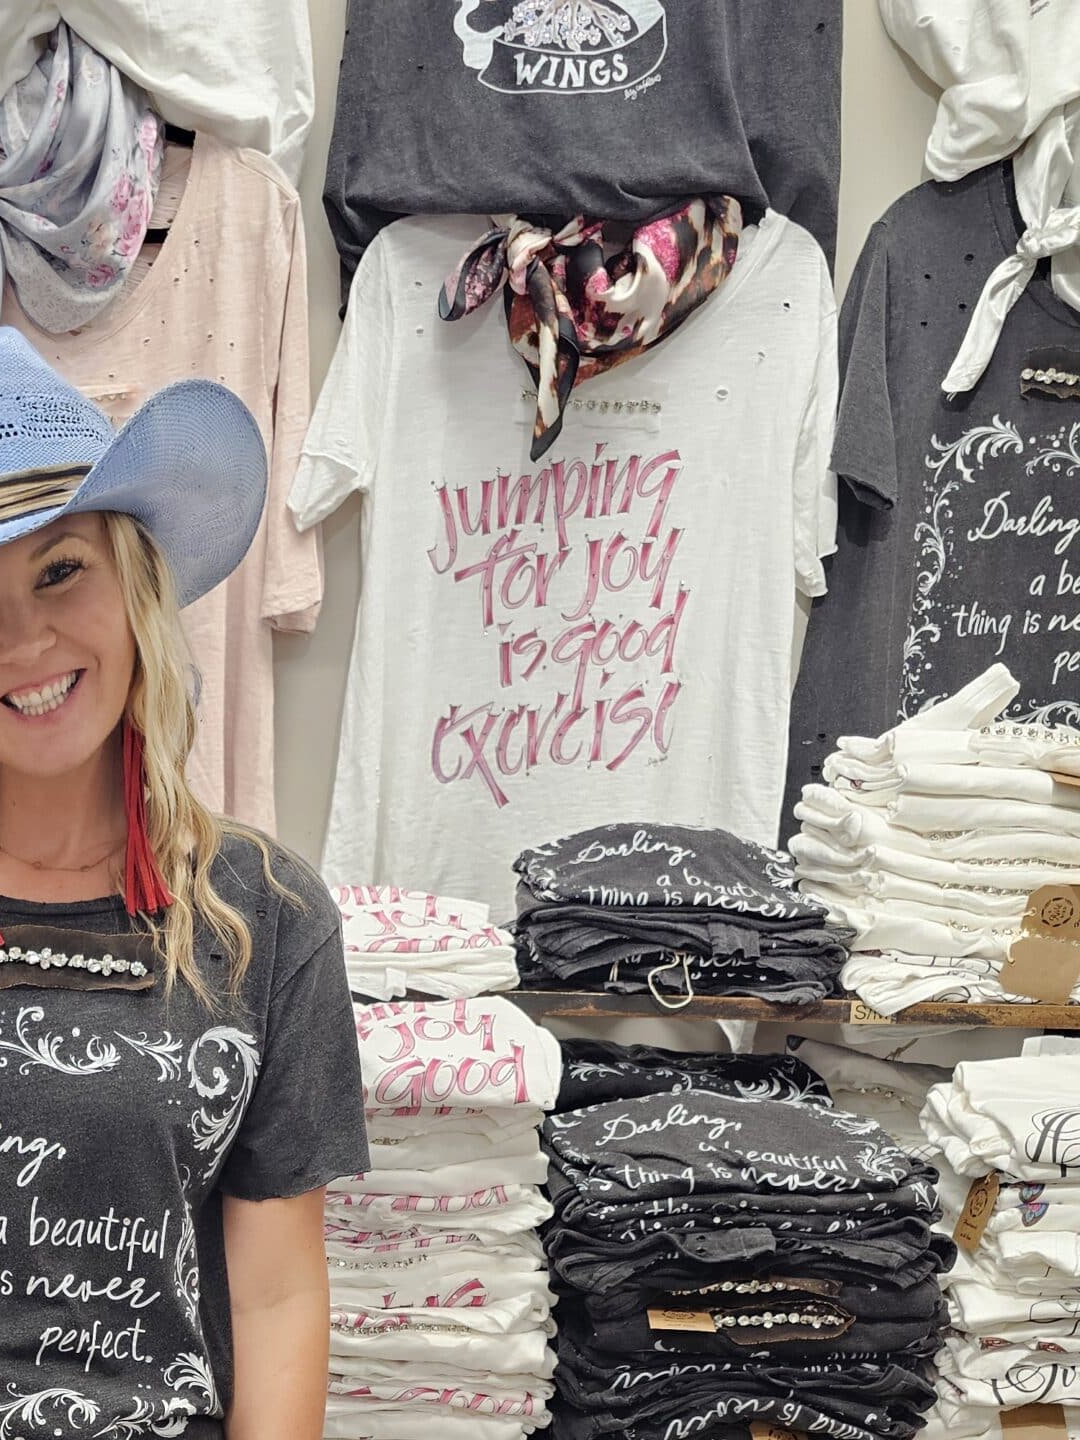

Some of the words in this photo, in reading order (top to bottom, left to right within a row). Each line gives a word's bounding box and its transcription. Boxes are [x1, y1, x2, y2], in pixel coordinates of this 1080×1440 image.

[514, 52, 629, 89] WINGS
[497, 620, 548, 688] is
[551, 582, 691, 714] good
[952, 601, 1013, 656] thing
[1022, 610, 1042, 635] is
[431, 671, 682, 810] exercise
[373, 1040, 530, 1109] good
[710, 1163, 732, 1180] is
[28, 1196, 170, 1270] beautiful
[26, 1273, 160, 1309] never
[35, 1318, 154, 1372] perfect.
